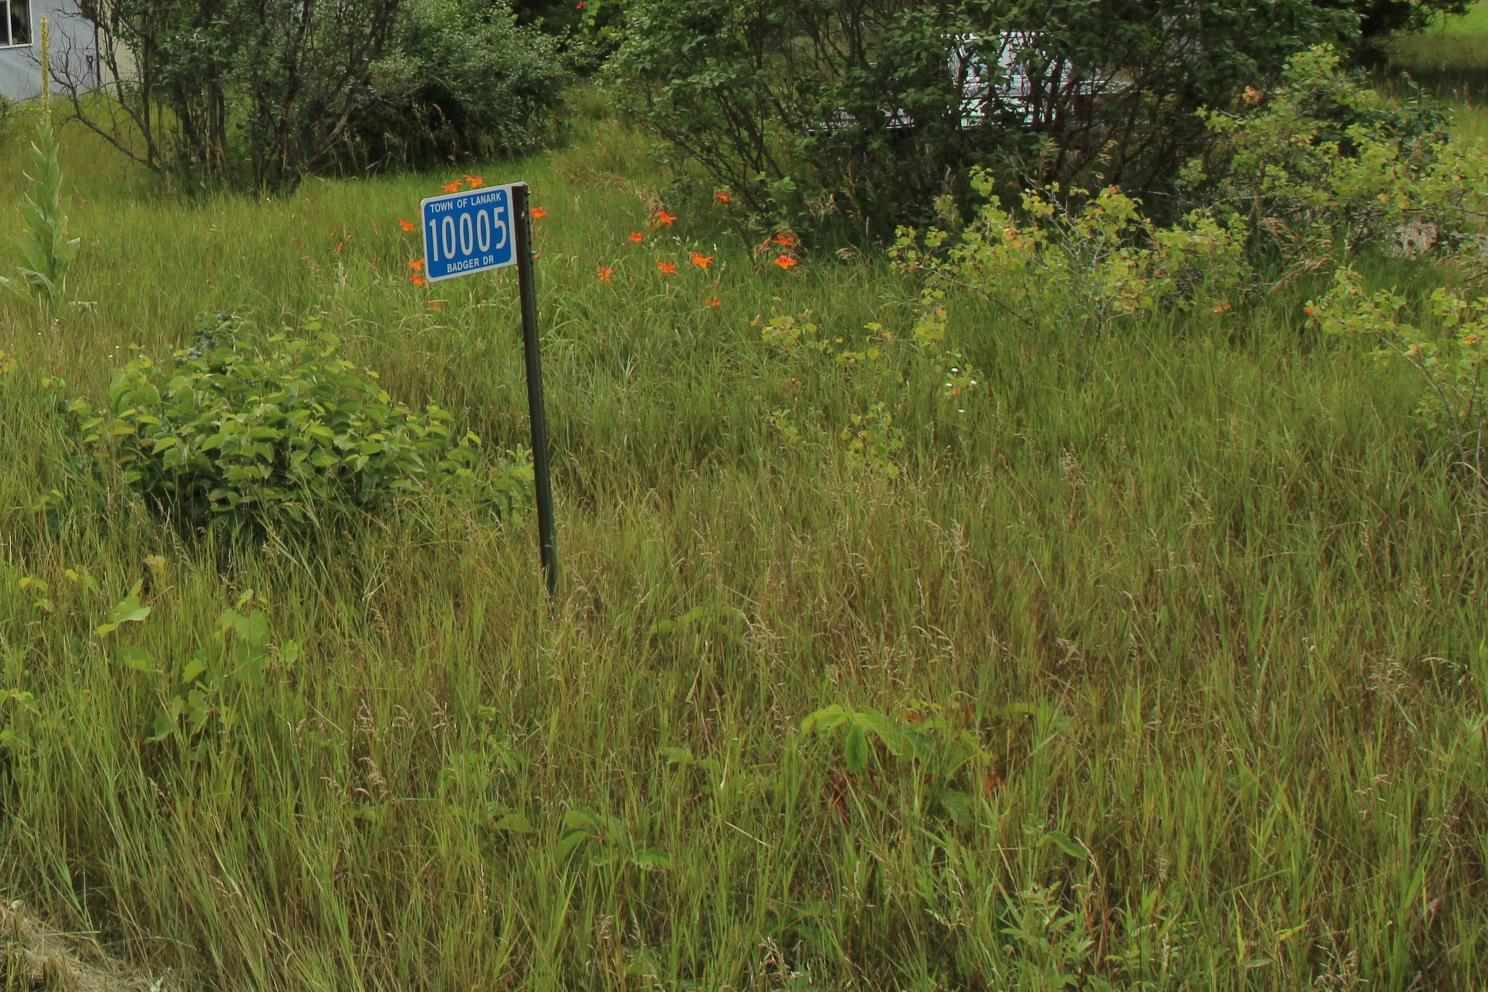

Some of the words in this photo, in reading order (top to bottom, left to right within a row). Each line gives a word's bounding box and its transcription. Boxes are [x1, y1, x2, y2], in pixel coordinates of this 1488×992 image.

[430, 204, 454, 214] TOWN
[457, 199, 468, 209] OF
[471, 191, 502, 206] LANARK
[429, 206, 507, 262] 10005
[447, 259, 480, 273] BADGER
[483, 255, 494, 265] DR
